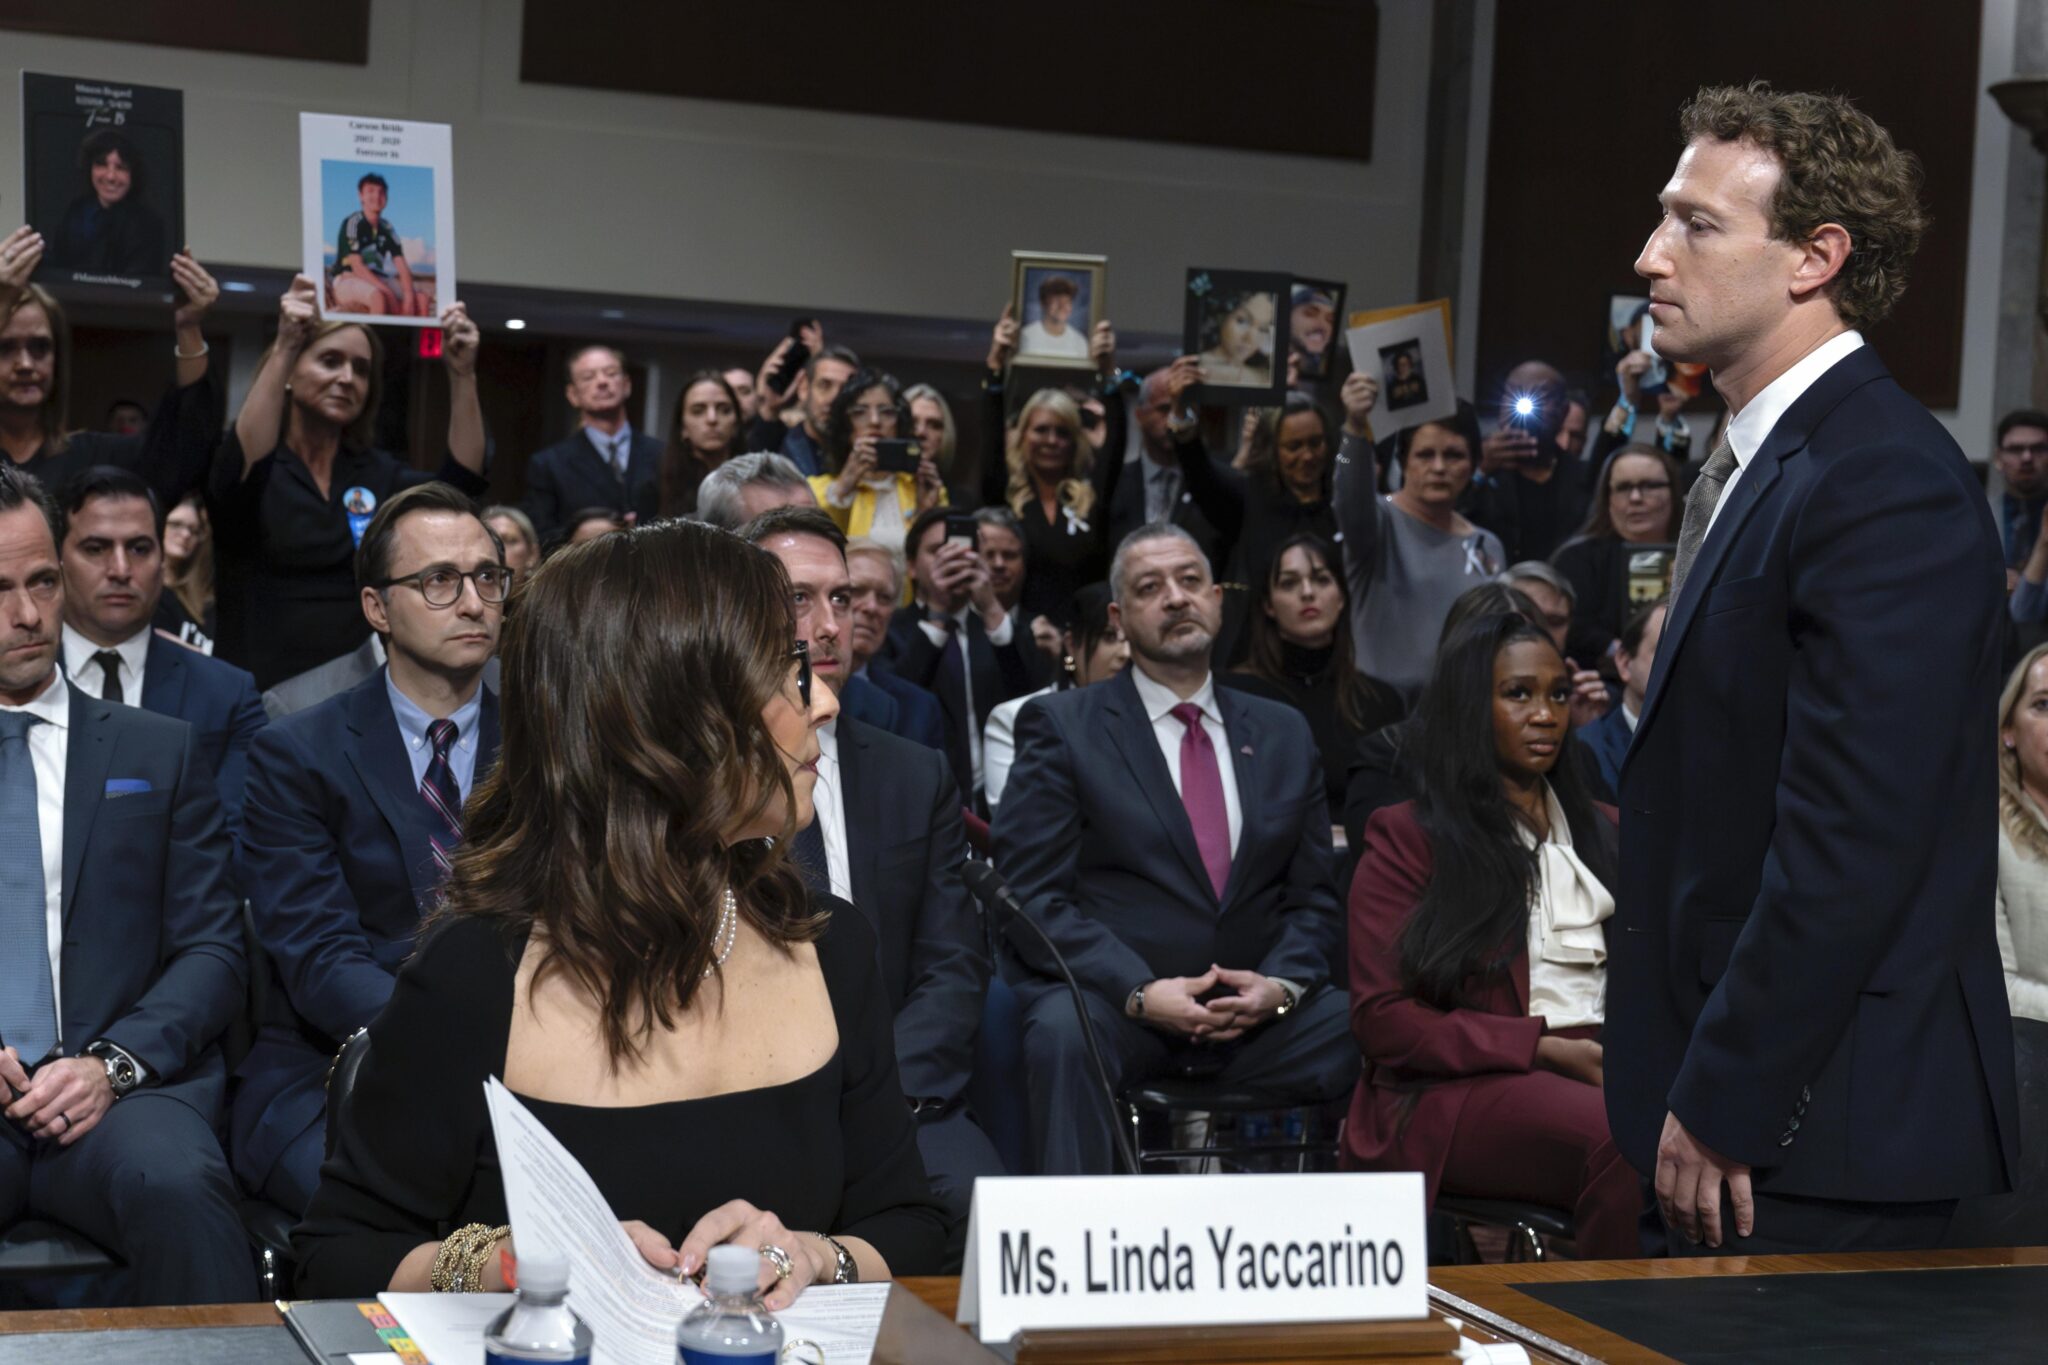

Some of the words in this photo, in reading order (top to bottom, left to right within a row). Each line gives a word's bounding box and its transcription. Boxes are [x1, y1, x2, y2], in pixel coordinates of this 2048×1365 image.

[1000, 1231, 1068, 1295] Ms.
[1085, 1228, 1194, 1293] Linda
[1207, 1224, 1404, 1290] Yaccarino
